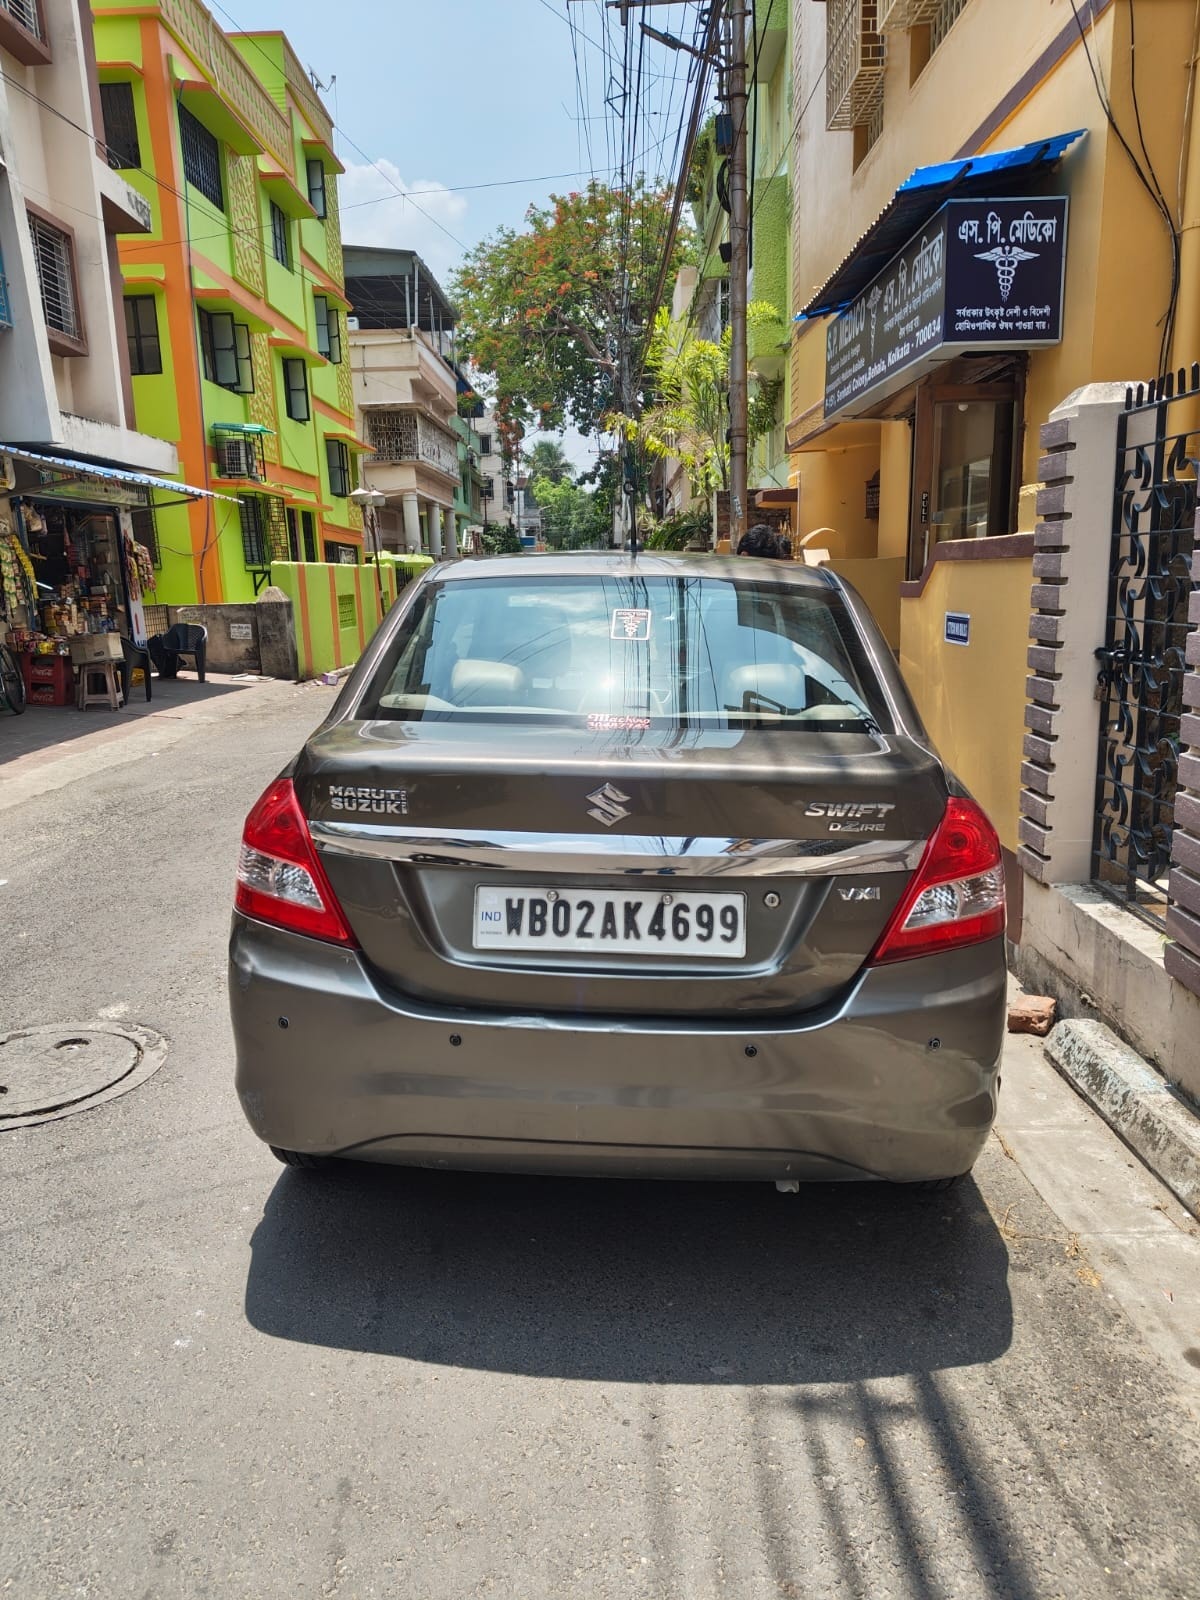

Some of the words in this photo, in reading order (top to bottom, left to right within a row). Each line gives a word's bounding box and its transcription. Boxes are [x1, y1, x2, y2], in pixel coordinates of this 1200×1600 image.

[958, 219, 983, 243] এস.
[986, 211, 1006, 243] পি.
[1009, 211, 1057, 243] মেডিকো
[912, 226, 944, 293] মেডিকো
[838, 297, 866, 351] MEDICO
[1006, 305, 1021, 317] দেশী
[1022, 308, 1028, 316] ও
[1030, 305, 1051, 317] বিদেশী
[887, 341, 910, 367] Kolkata
[915, 314, 942, 348] 700034
[328, 785, 407, 800] MARUTI
[331, 797, 408, 815] SUZUKI
[804, 802, 897, 818] SWIFT
[481, 911, 502, 922] IND
[505, 897, 740, 943] WB02AK4699
